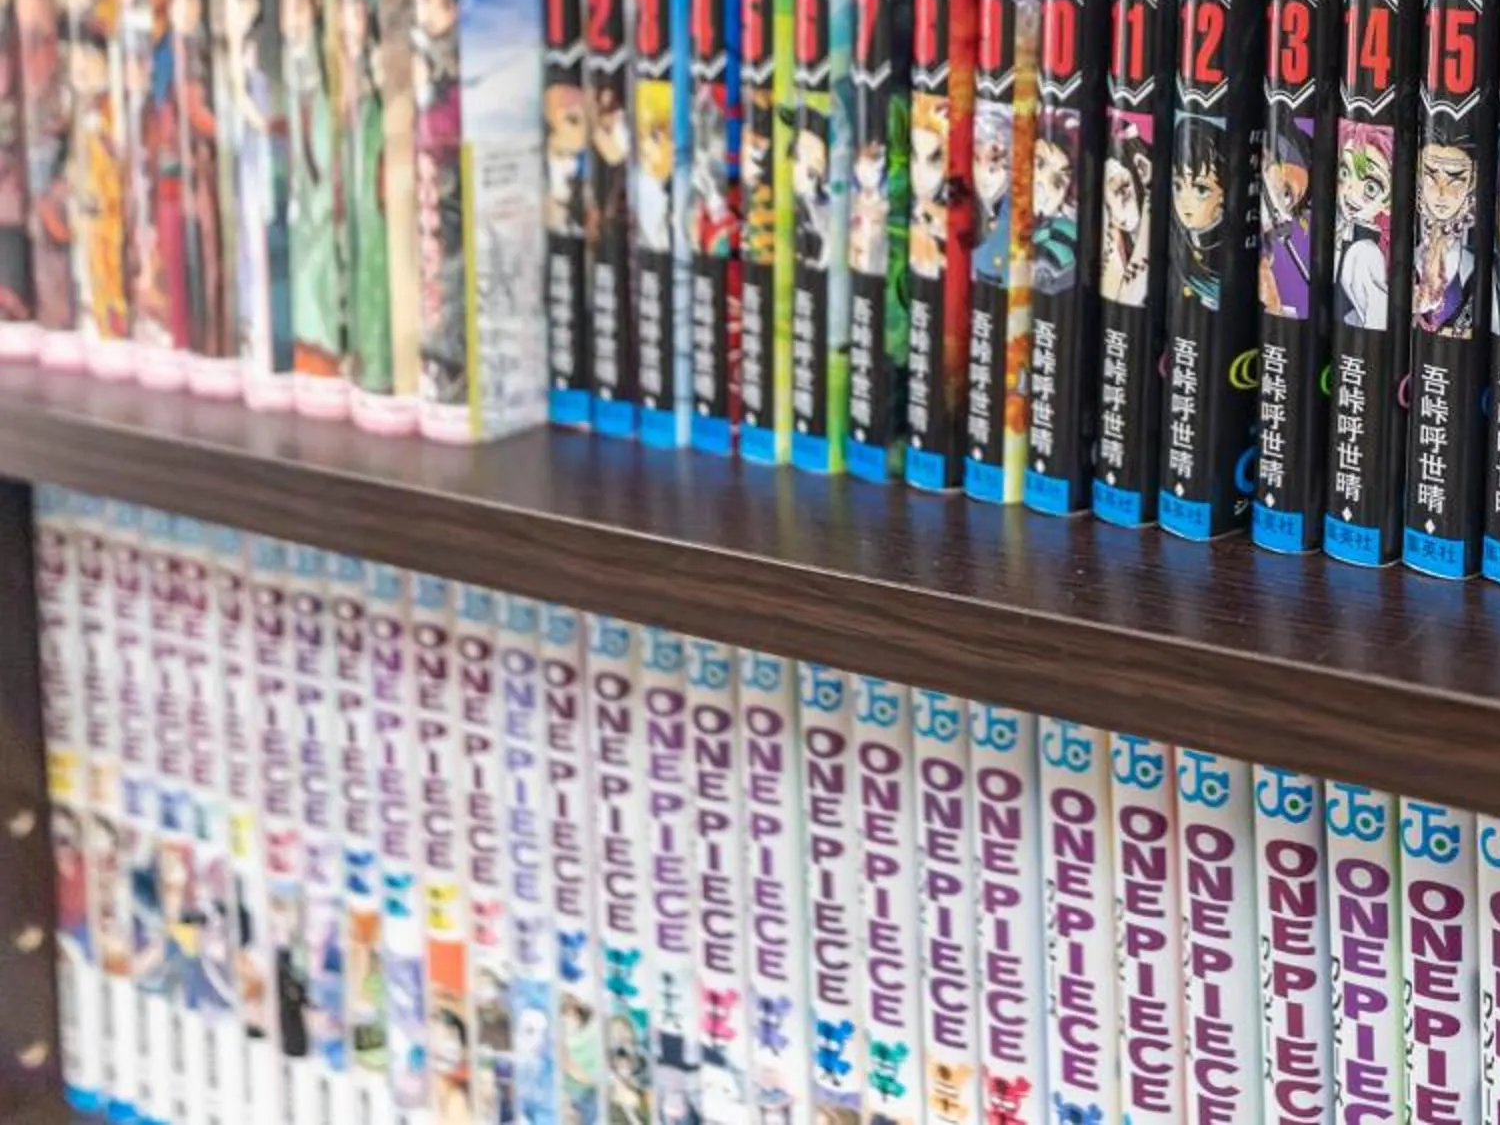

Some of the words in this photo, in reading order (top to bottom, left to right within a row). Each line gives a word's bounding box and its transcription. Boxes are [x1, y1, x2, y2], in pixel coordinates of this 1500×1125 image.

[1111, 3, 1145, 81] 11
[1180, 6, 1226, 84] 12
[1267, 0, 1310, 84] 13
[1344, 7, 1392, 91] 14
[1427, 8, 1476, 94] 15
[1100, 328, 1128, 468] 吾峠呼世晴
[1169, 336, 1199, 478] 吾峠呼世晴
[1258, 341, 1288, 489] 吾峠呼世晴
[1335, 354, 1366, 502] 吾峠呼世晴
[1417, 364, 1449, 515] 吾峠呼世晴
[333, 596, 365, 681] ONE
[371, 615, 402, 702] ONE
[414, 623, 447, 711] ONE
[460, 635, 493, 724] ONE
[502, 648, 535, 743] ONE
[543, 658, 577, 752] ONE
[593, 671, 632, 766] ONE
[645, 687, 686, 784] ONE
[692, 704, 732, 803] ONE
[745, 705, 784, 805] ONE
[375, 710, 408, 859] PIECE
[419, 719, 453, 868] PIECE
[465, 734, 498, 887] PIECE
[506, 748, 541, 904] PIECE
[548, 759, 584, 917] PIECE
[805, 726, 846, 829] ONE
[858, 741, 901, 847] ONE
[920, 757, 964, 865] ONE
[977, 767, 1023, 876] ONE
[600, 776, 639, 935] PIECE
[650, 791, 690, 955] PIECE
[699, 811, 736, 975] PIECE
[750, 812, 789, 982] PIECE
[1050, 788, 1096, 900] ONE
[1119, 806, 1168, 919] ONE
[1185, 824, 1234, 940] ONE
[1265, 840, 1318, 956] ONE
[810, 834, 851, 1007] PIECE
[864, 853, 906, 1027] PIECE
[926, 870, 969, 1051] PIECE
[983, 881, 1029, 1064] PIECE
[1335, 858, 1390, 979] ONE
[1408, 880, 1465, 1003] ONE
[1056, 903, 1101, 1092] PIECE
[1126, 922, 1174, 1114] PIECE
[1191, 942, 1240, 1125] PIECE
[1272, 961, 1325, 1125] PIEC
